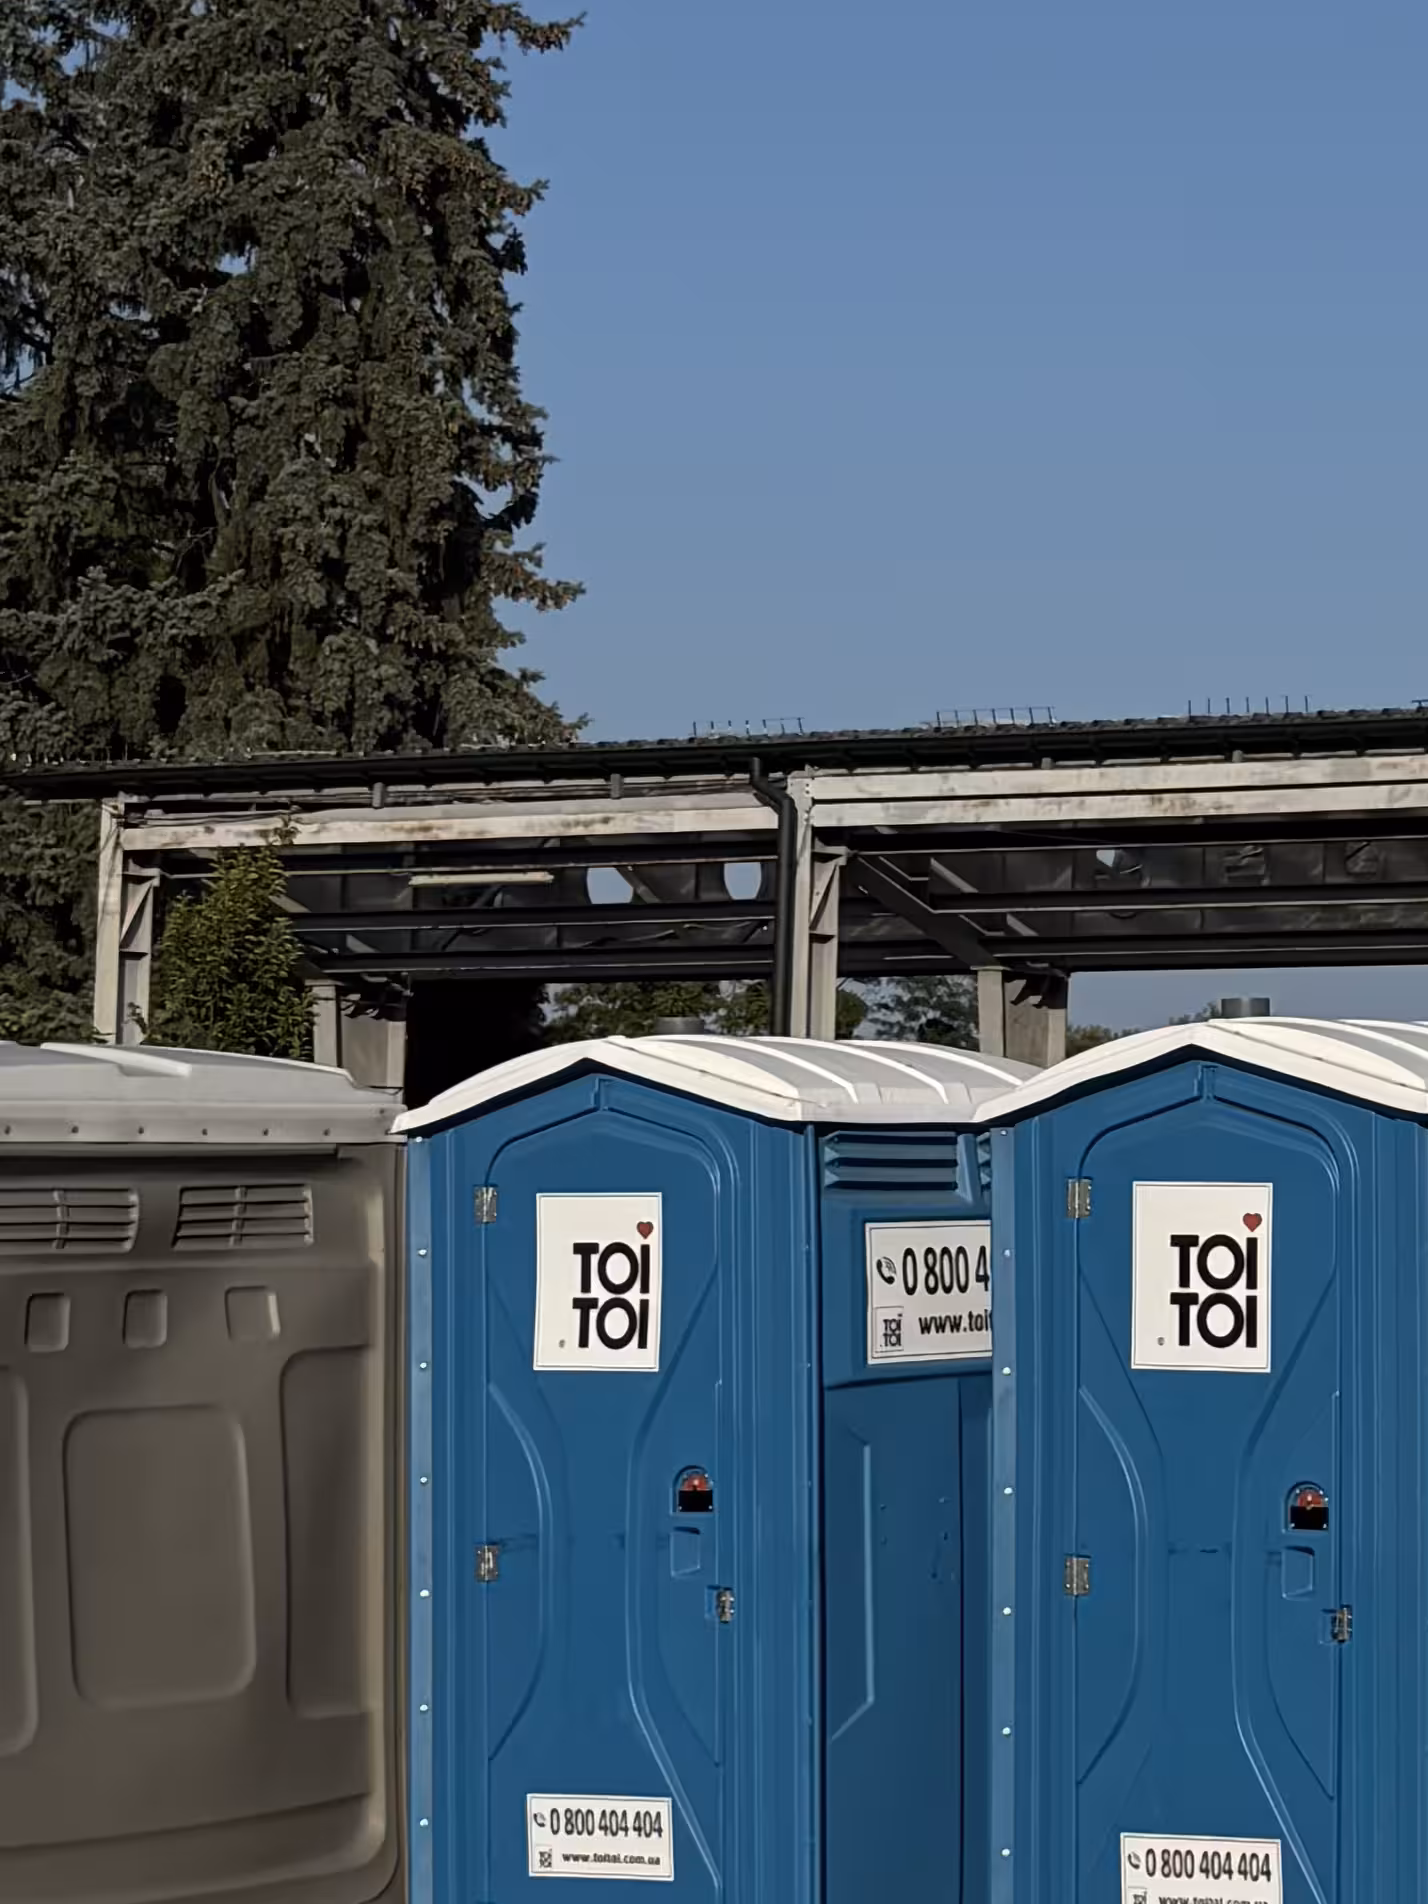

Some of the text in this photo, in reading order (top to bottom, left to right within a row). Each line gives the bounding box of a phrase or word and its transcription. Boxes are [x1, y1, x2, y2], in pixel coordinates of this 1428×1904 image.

[573, 1241, 650, 1294] TOI
[903, 1247, 918, 1296] 0
[924, 1246, 969, 1295] 800
[1170, 1234, 1258, 1290] TOI
[572, 1297, 648, 1349] TOI
[918, 1309, 992, 1335] www.toi
[1170, 1293, 1258, 1348] TOI
[550, 1808, 663, 1838] 0 800 404 404
[1145, 1848, 1271, 1882] 0 800 404 404
